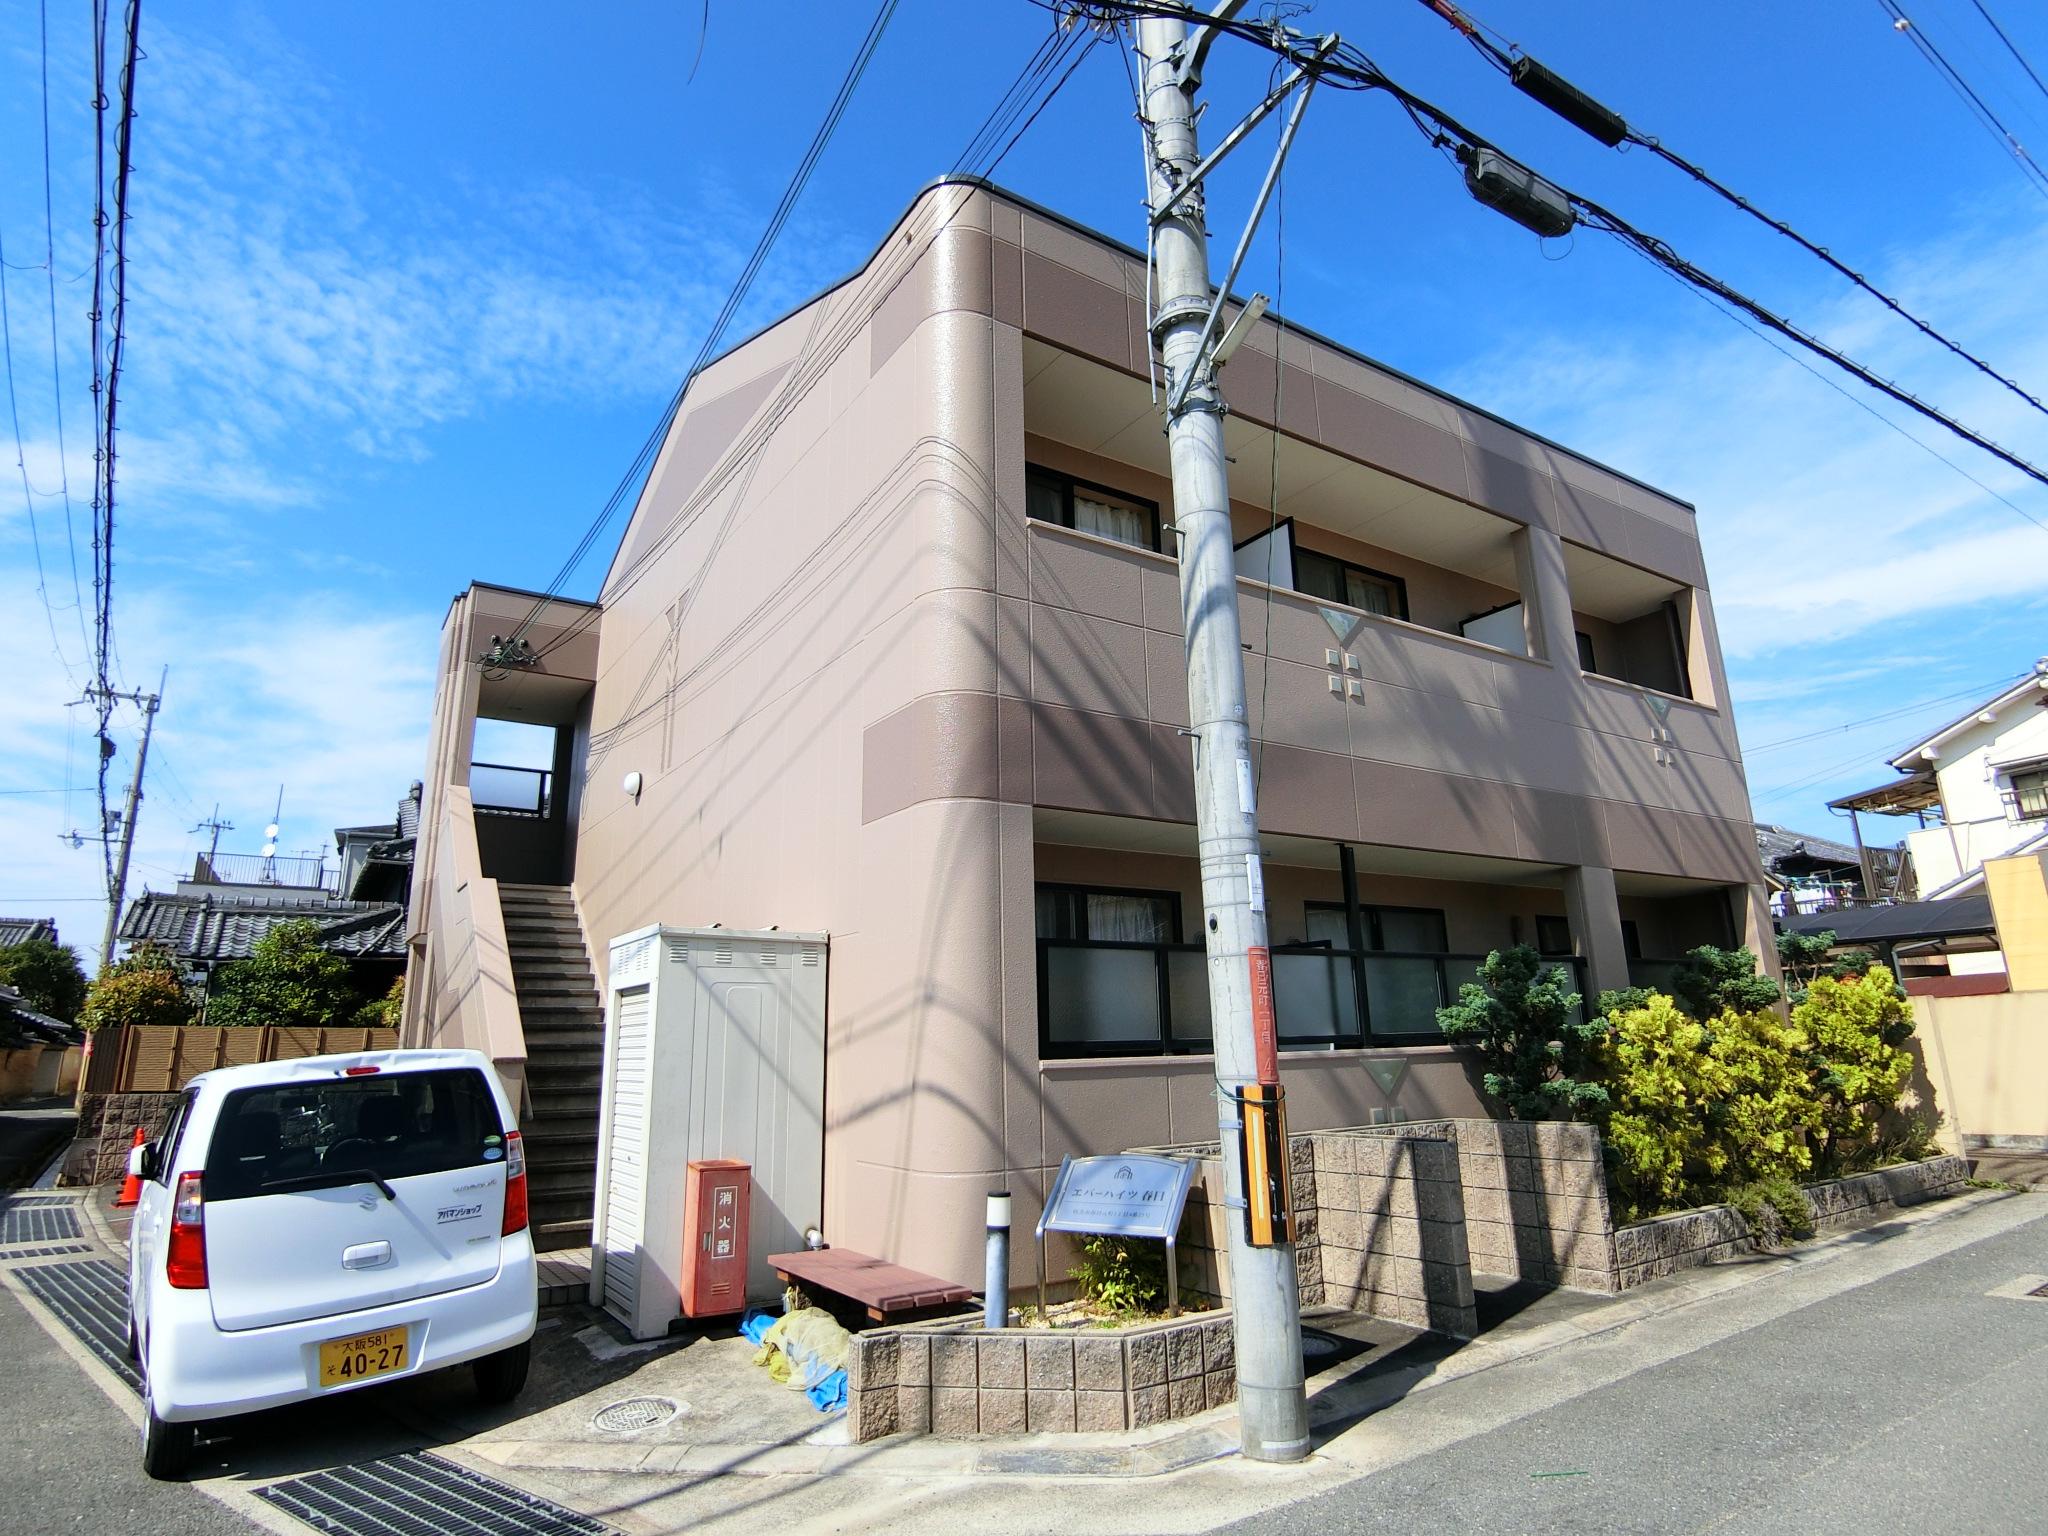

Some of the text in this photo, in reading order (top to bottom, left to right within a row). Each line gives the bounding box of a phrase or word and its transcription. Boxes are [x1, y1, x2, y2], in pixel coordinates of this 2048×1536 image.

[717, 1191, 733, 1254] 消火器
[340, 1344, 403, 1377] 40-27
